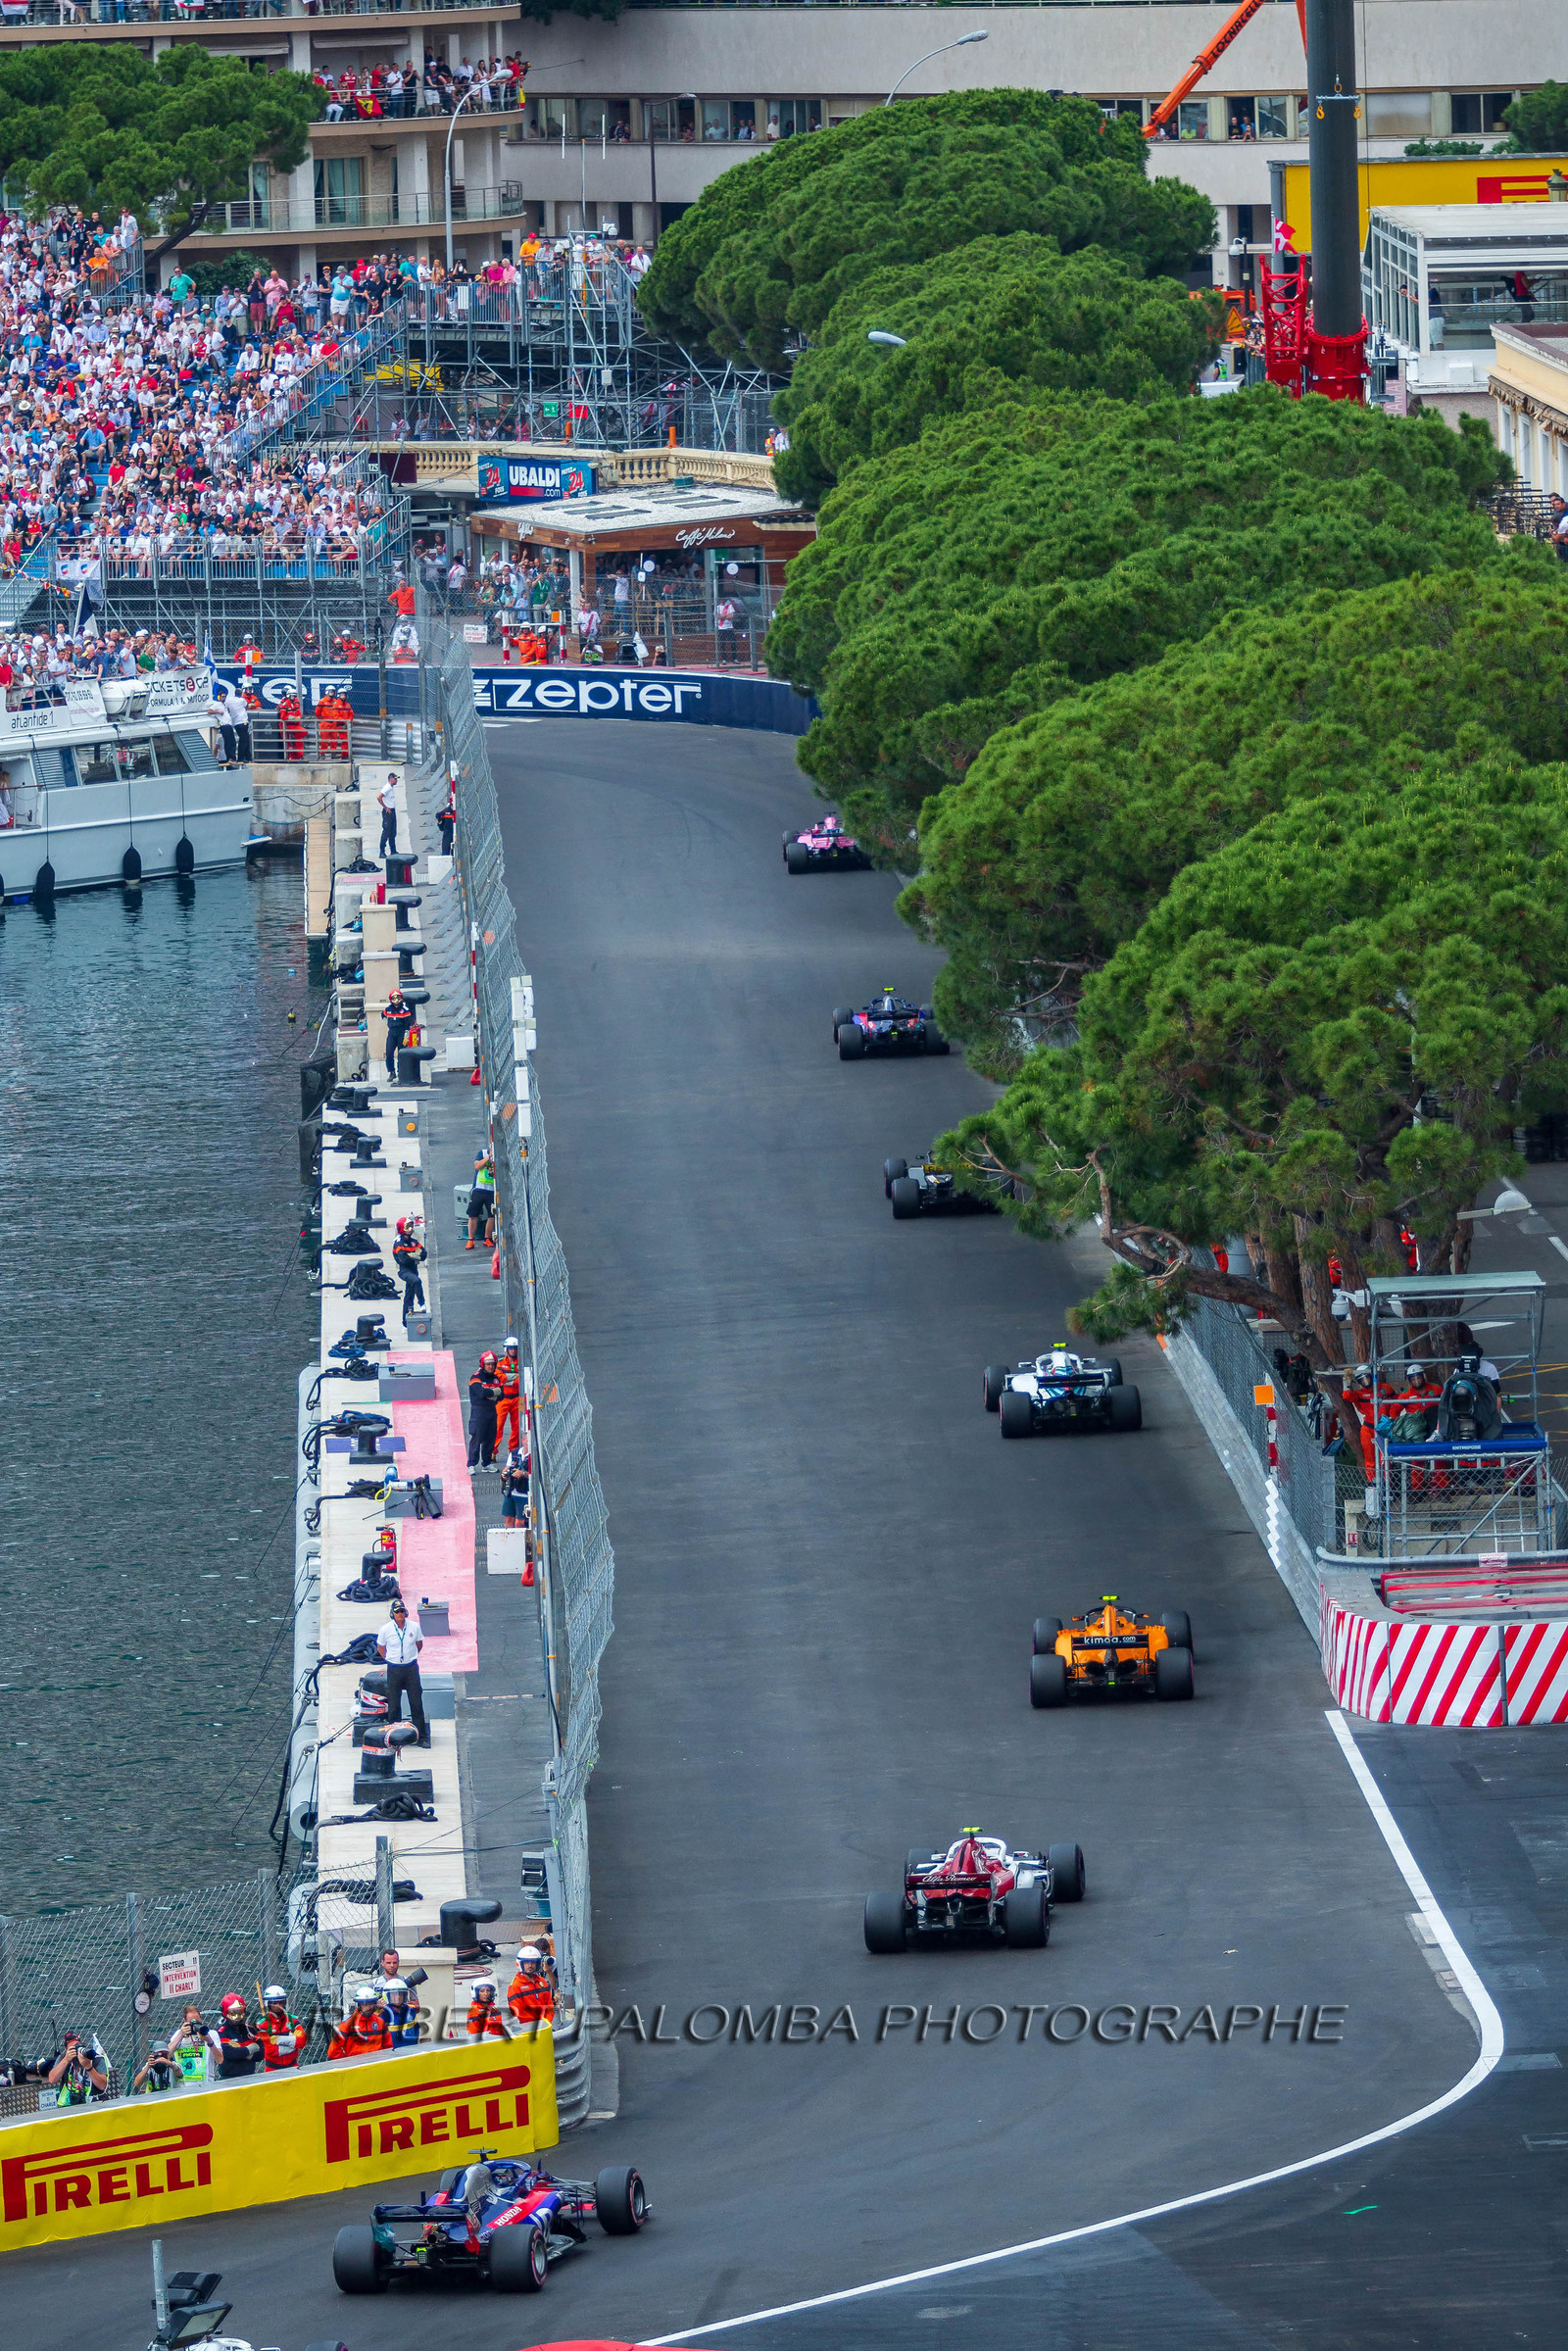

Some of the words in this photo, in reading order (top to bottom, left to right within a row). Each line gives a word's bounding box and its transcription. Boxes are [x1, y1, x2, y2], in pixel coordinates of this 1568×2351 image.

[1211, 0, 1265, 59] LOCNACELL
[485, 466, 501, 489] 24
[509, 465, 561, 488] UBALDI
[568, 470, 584, 494] 24
[544, 488, 561, 497] .com
[187, 694, 210, 704] MOTOGP
[11, 711, 48, 729] atlantide
[50, 710, 54, 724] 1
[162, 1959, 185, 1971] SECTEUR
[164, 1969, 197, 1984] INTERVENTION
[174, 1981, 194, 1993] CHARLY
[323, 2065, 531, 2164] PIRELLI
[1, 2123, 214, 2223] PIRELLI
[494, 2205, 523, 2227] HONDA
